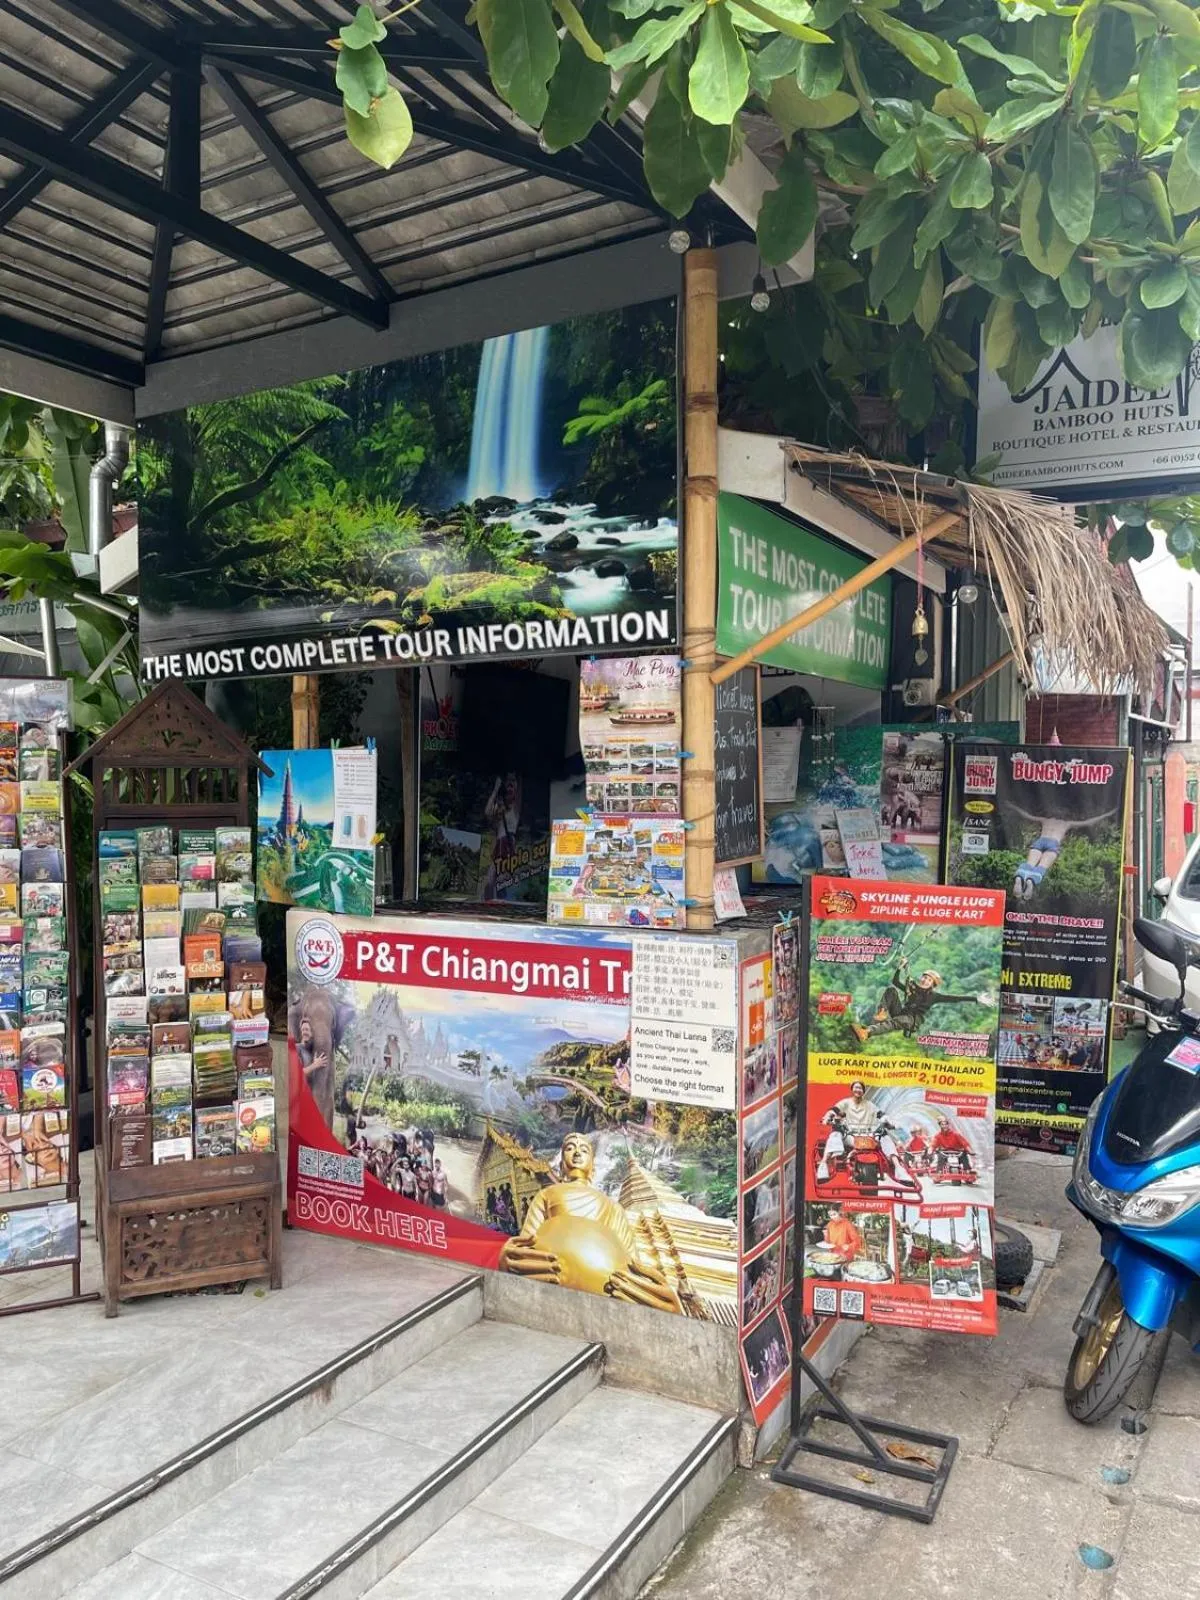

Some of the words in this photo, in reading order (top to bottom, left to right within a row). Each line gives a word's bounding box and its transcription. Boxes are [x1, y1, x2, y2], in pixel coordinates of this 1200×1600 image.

[1033, 411, 1113, 431] BAMBOO
[1124, 404, 1174, 421] HUTS
[992, 433, 1066, 451] BOUTIQUE
[1069, 430, 1119, 443] HOTEL
[1123, 427, 1133, 437] &
[992, 460, 1124, 482] JAIDEEBAMBOOHUTS.COM
[729, 526, 768, 578] THE
[772, 546, 815, 592] MOST
[730, 584, 783, 635] TOUR
[142, 656, 181, 681] THE
[186, 648, 245, 676] MOST
[250, 633, 377, 669] COMPLETE
[383, 628, 453, 659] TOUR
[458, 609, 670, 656] INFORMATION
[1012, 759, 1065, 784] BUNGY
[1070, 763, 1114, 785] JUMP
[967, 777, 995, 787] JUMP
[860, 892, 911, 904] SKYLINE
[913, 894, 961, 906] JUNGLE
[962, 897, 996, 908] LUGE
[870, 907, 909, 916] ZIPLINE
[912, 908, 920, 916] &
[923, 909, 951, 918] LUGE
[954, 910, 986, 919] KART
[307, 940, 333, 953] P&T
[191, 963, 221, 973] GEMS
[356, 941, 415, 973] P&T
[422, 946, 591, 993] Chiangmai
[1019, 971, 1073, 990] EXTREME
[635, 1026, 663, 1037] Ancient
[665, 1029, 681, 1039] Thai
[683, 1032, 707, 1042] Lanna
[654, 1043, 675, 1053] Change
[673, 1067, 692, 1075] perfect
[818, 1058, 842, 1066] LUGE
[844, 1059, 869, 1068] KART
[872, 1060, 897, 1069] ONLY
[899, 1061, 919, 1070] ONE
[933, 1063, 985, 1075] THAILAND
[634, 1073, 663, 1085] Choose
[665, 1078, 677, 1087] the
[679, 1079, 696, 1090] right
[698, 1082, 724, 1093] format
[836, 1069, 862, 1077] DOWN
[918, 1072, 956, 1087] 2,100
[997, 1116, 1050, 1126] AUTHORIZED
[1052, 1120, 1080, 1129] AGENT
[295, 1191, 372, 1232] BOOK
[374, 1208, 447, 1249] HERE
